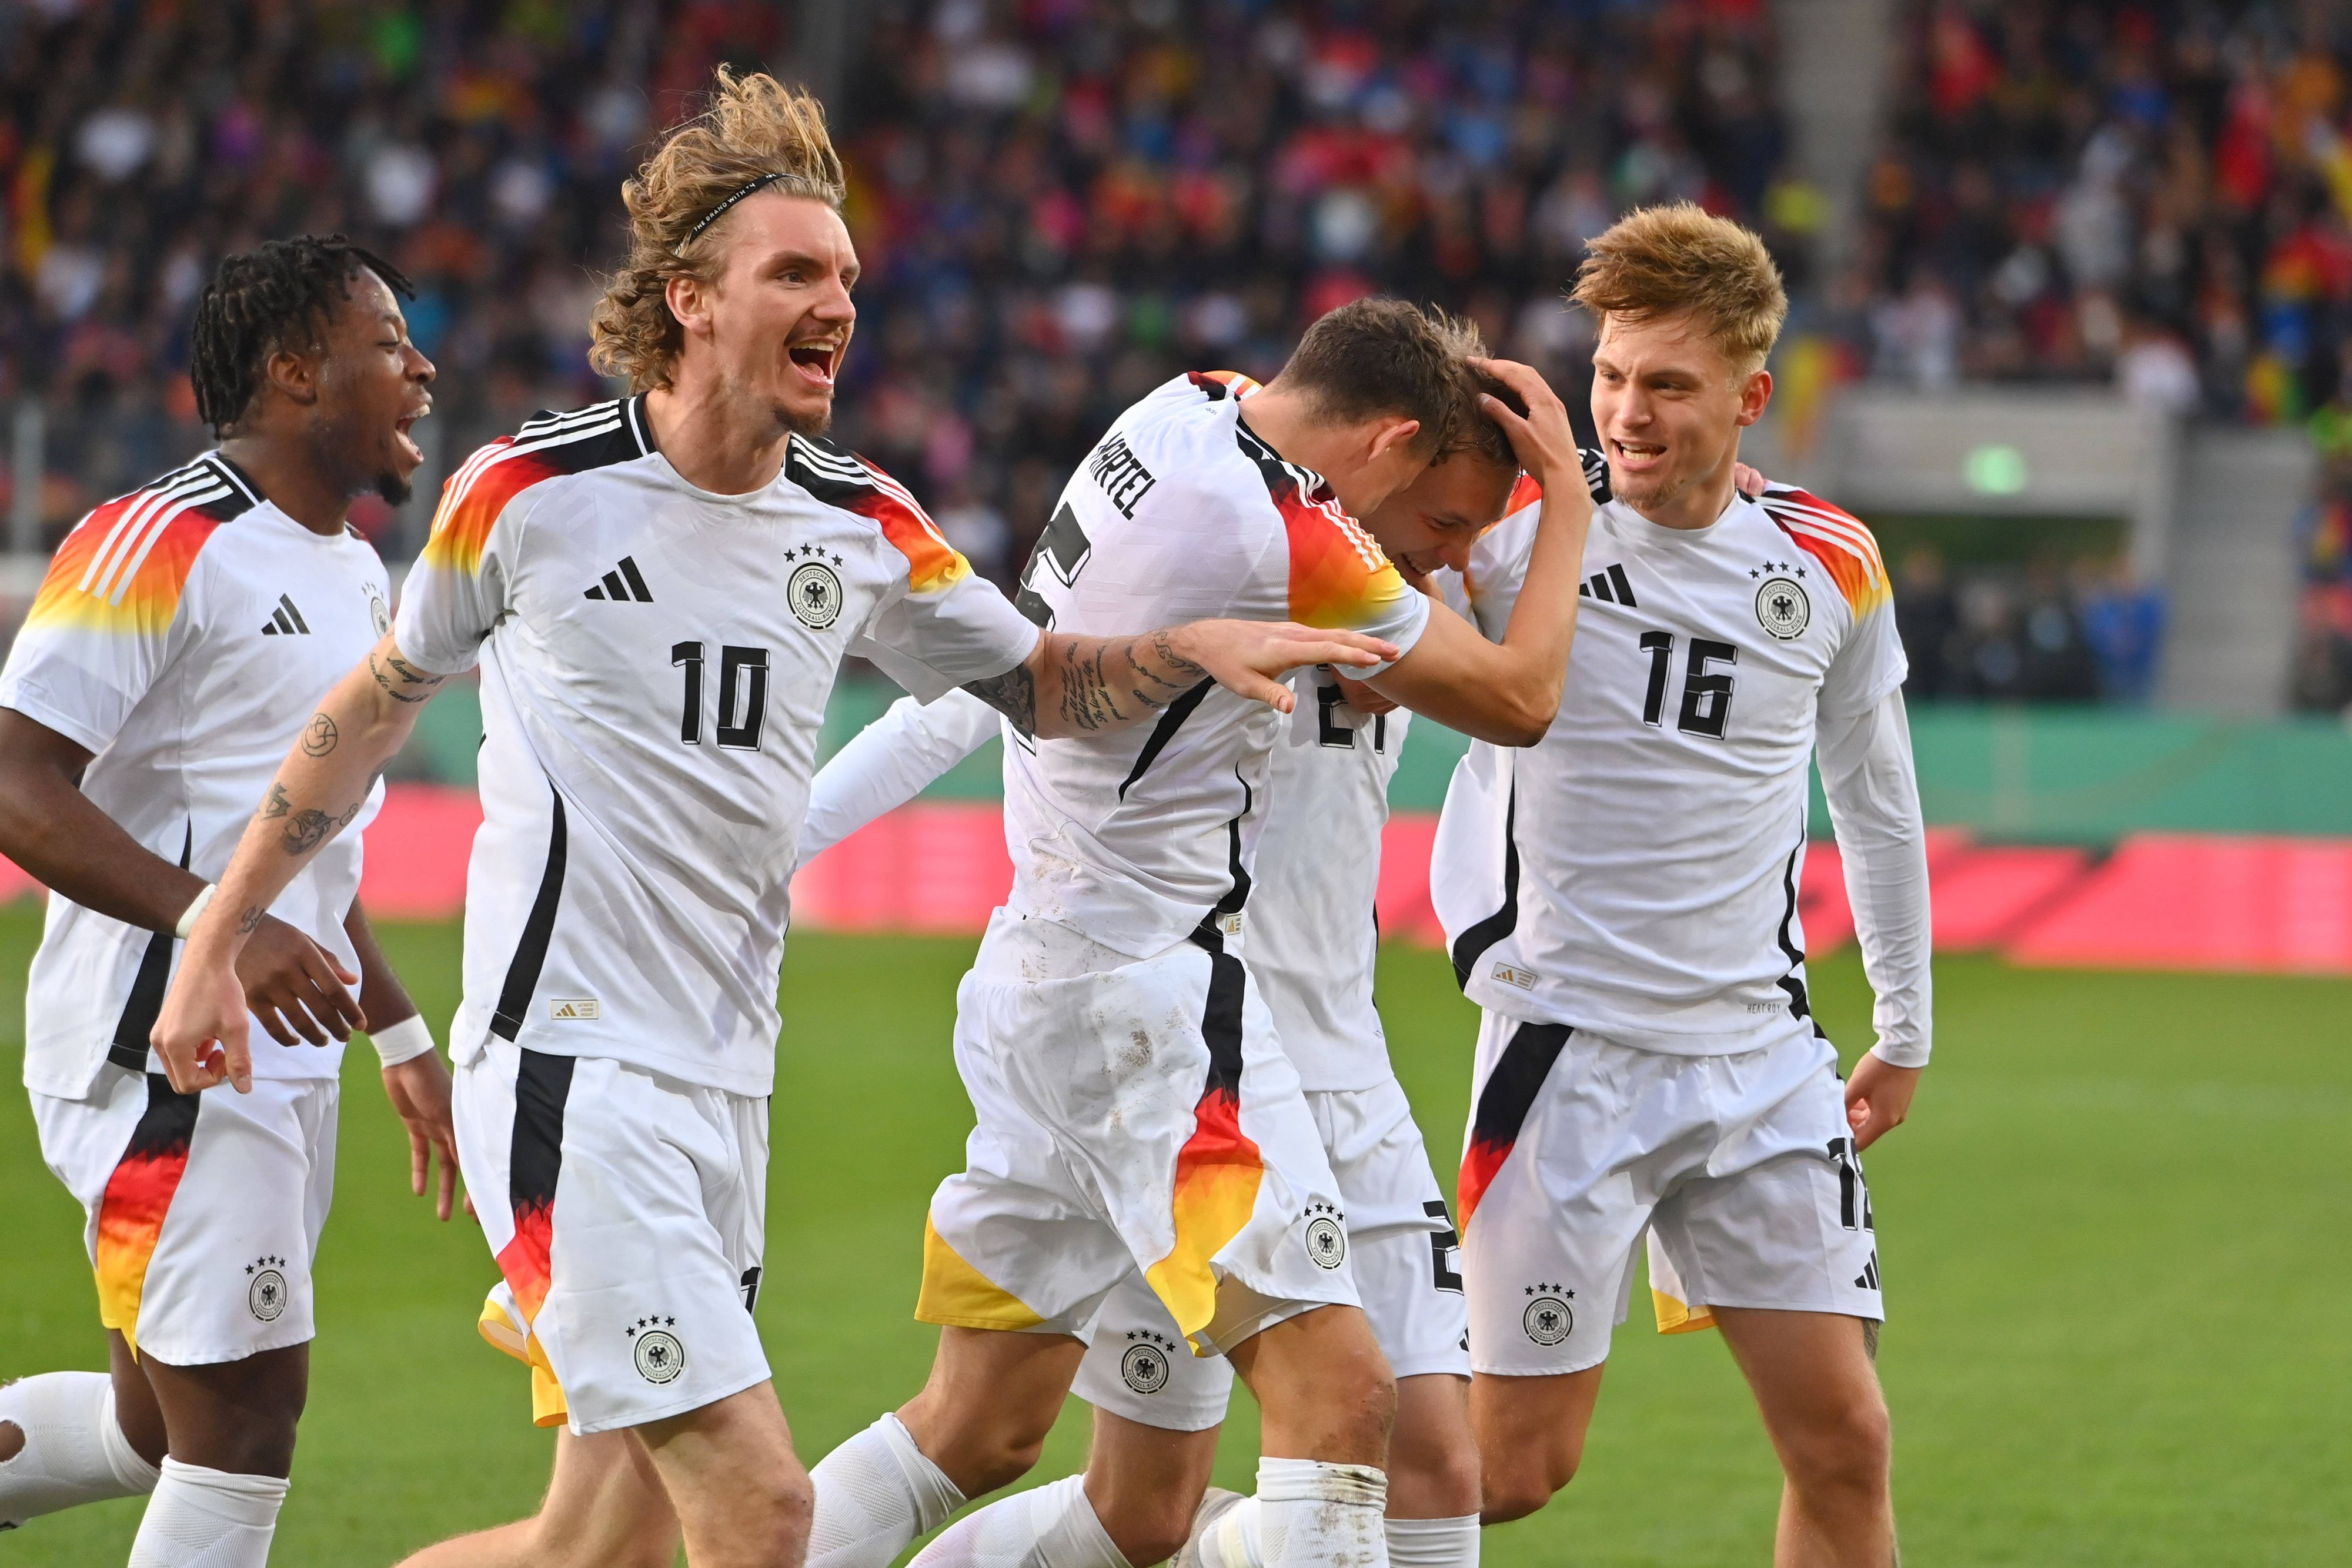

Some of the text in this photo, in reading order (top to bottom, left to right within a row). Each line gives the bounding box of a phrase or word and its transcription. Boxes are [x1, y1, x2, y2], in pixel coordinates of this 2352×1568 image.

[694, 189, 746, 232] THE BRAND WITH
[799, 571, 831, 584] DEUTSCHER
[1766, 586, 1797, 597] DEUTSCHER
[797, 602, 834, 621] FUSSBALL-BUND
[1765, 615, 1802, 632] FUSSBALL-BUND
[1639, 631, 1738, 740] 16
[671, 641, 770, 751] 10
[1535, 1303, 1563, 1313] DEUTSCHER
[1531, 1325, 1564, 1339] FUSSBALL-BUND
[642, 1338, 669, 1350] DEUTSCHER
[1134, 1350, 1160, 1363] DEUTSCHER
[1128, 1369, 1160, 1387] FUSSBALL-BUND
